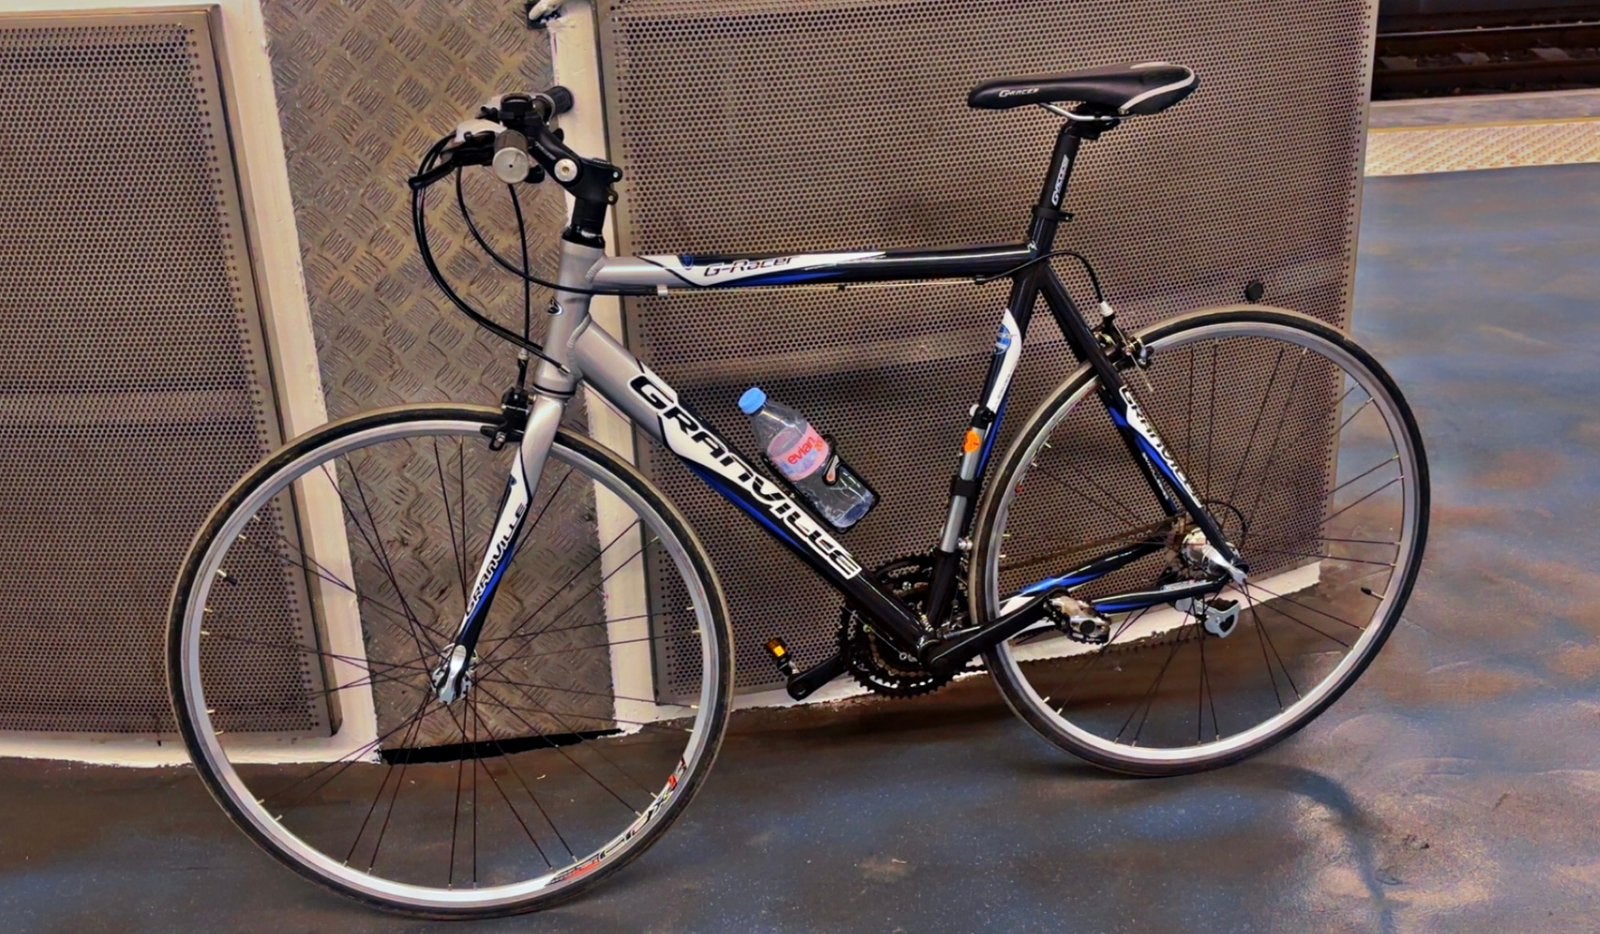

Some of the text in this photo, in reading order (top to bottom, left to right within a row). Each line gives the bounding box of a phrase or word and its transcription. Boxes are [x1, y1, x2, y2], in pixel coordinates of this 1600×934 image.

[703, 257, 792, 277] G-Racer
[629, 375, 863, 580] GRANVILLE
[787, 436, 815, 465] evian
[466, 502, 527, 617] GRANVILLE
